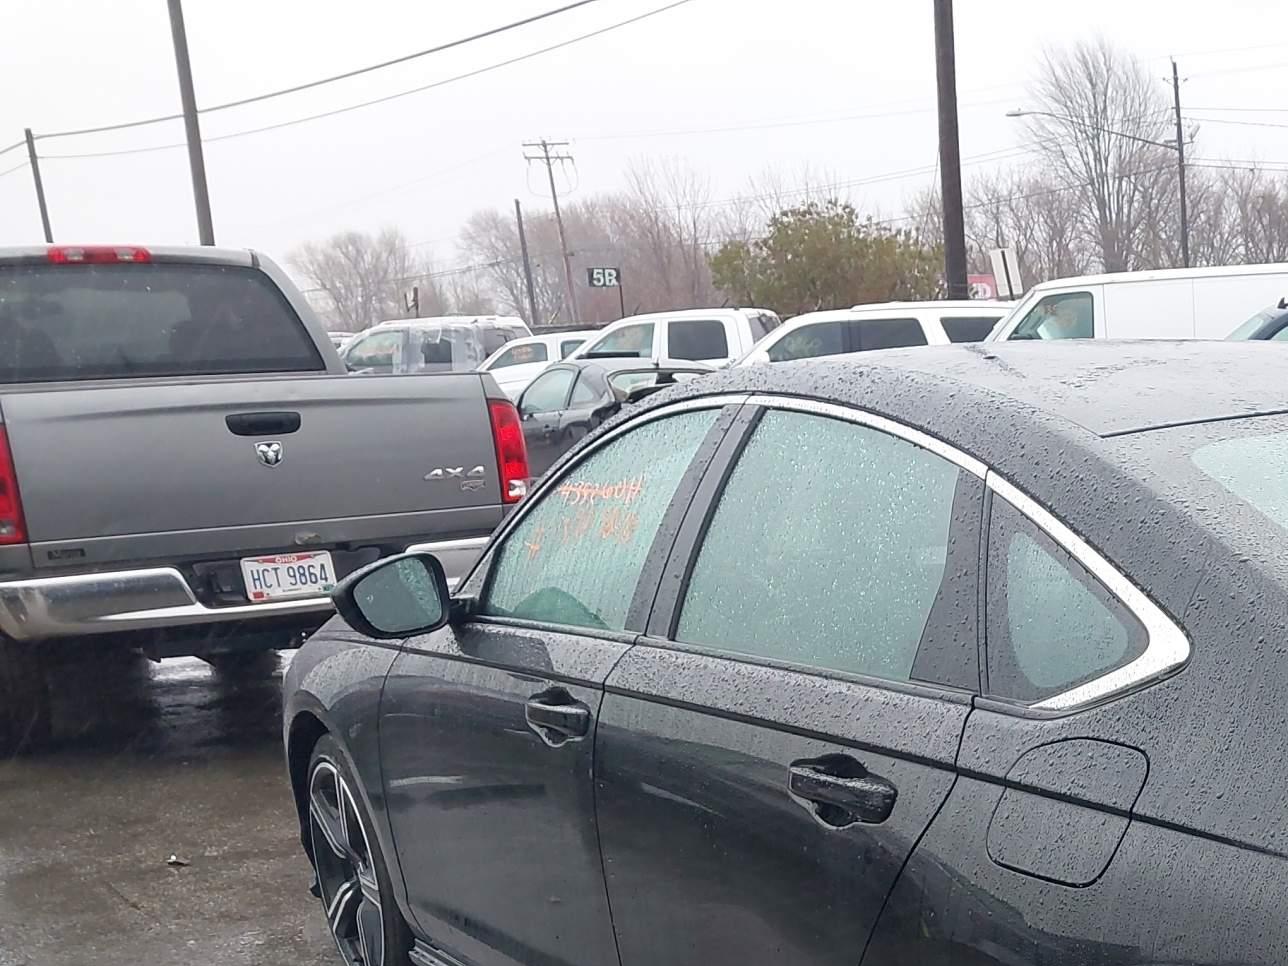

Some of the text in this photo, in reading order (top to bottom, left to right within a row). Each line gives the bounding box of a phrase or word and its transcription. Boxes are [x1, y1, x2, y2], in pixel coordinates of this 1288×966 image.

[274, 555, 298, 563] OHIO
[250, 563, 329, 590] HCT 9864
